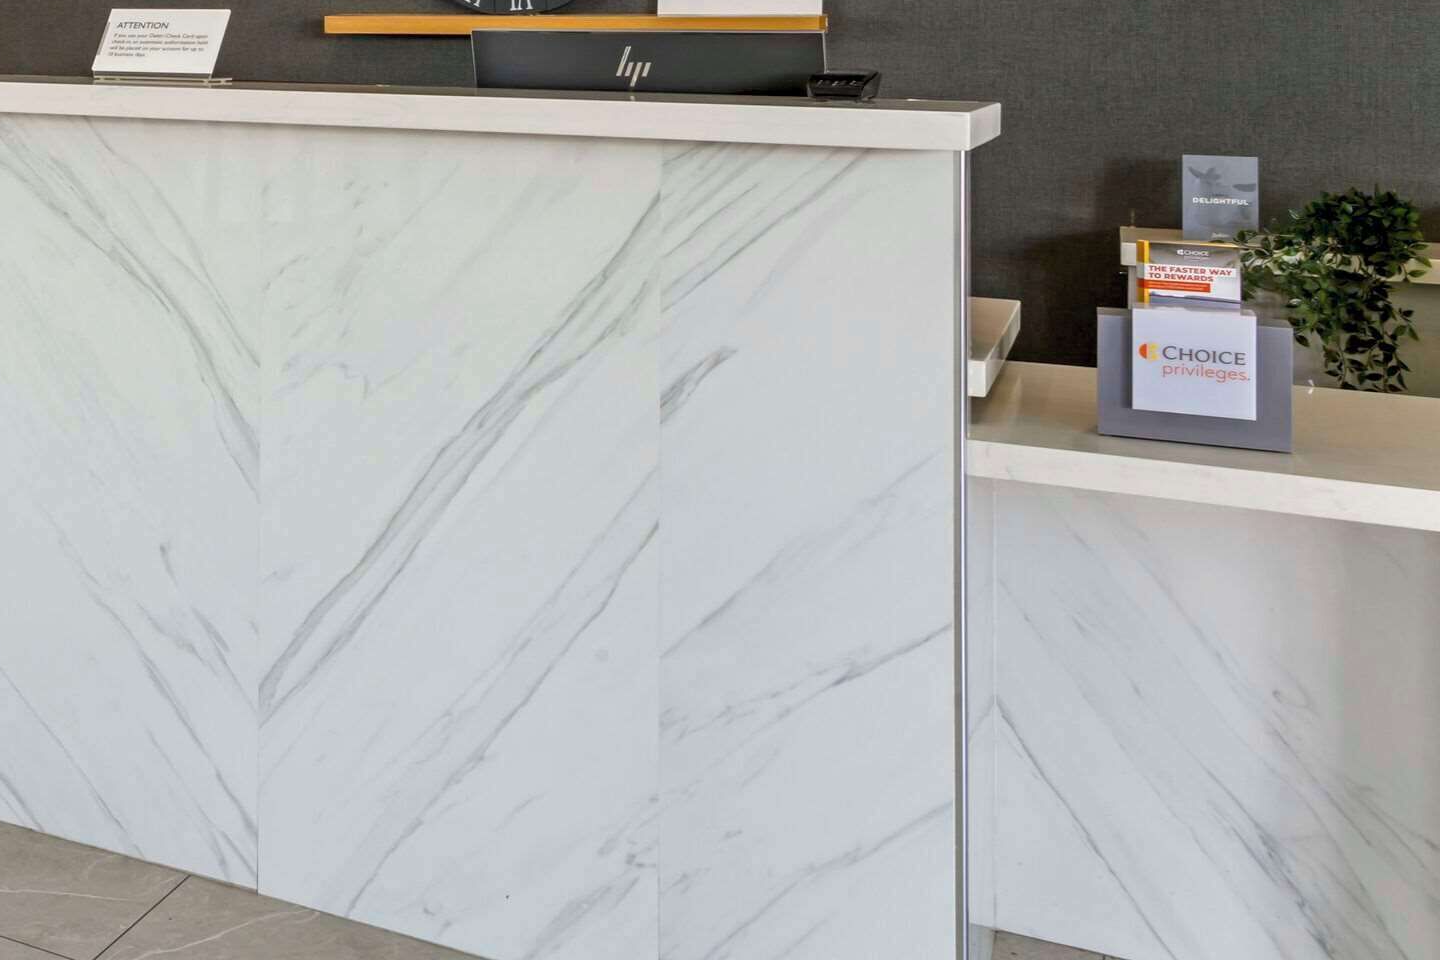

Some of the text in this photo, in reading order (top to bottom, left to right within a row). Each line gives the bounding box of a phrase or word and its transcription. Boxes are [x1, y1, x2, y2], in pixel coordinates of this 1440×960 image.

[616, 46, 651, 87] hp
[1192, 197, 1249, 206] DELIGHTFUL
[1169, 266, 1206, 274] FASTER
[1209, 268, 1232, 276] WAY
[1164, 273, 1214, 282] REWARDS
[1162, 345, 1247, 366] CHOICE
